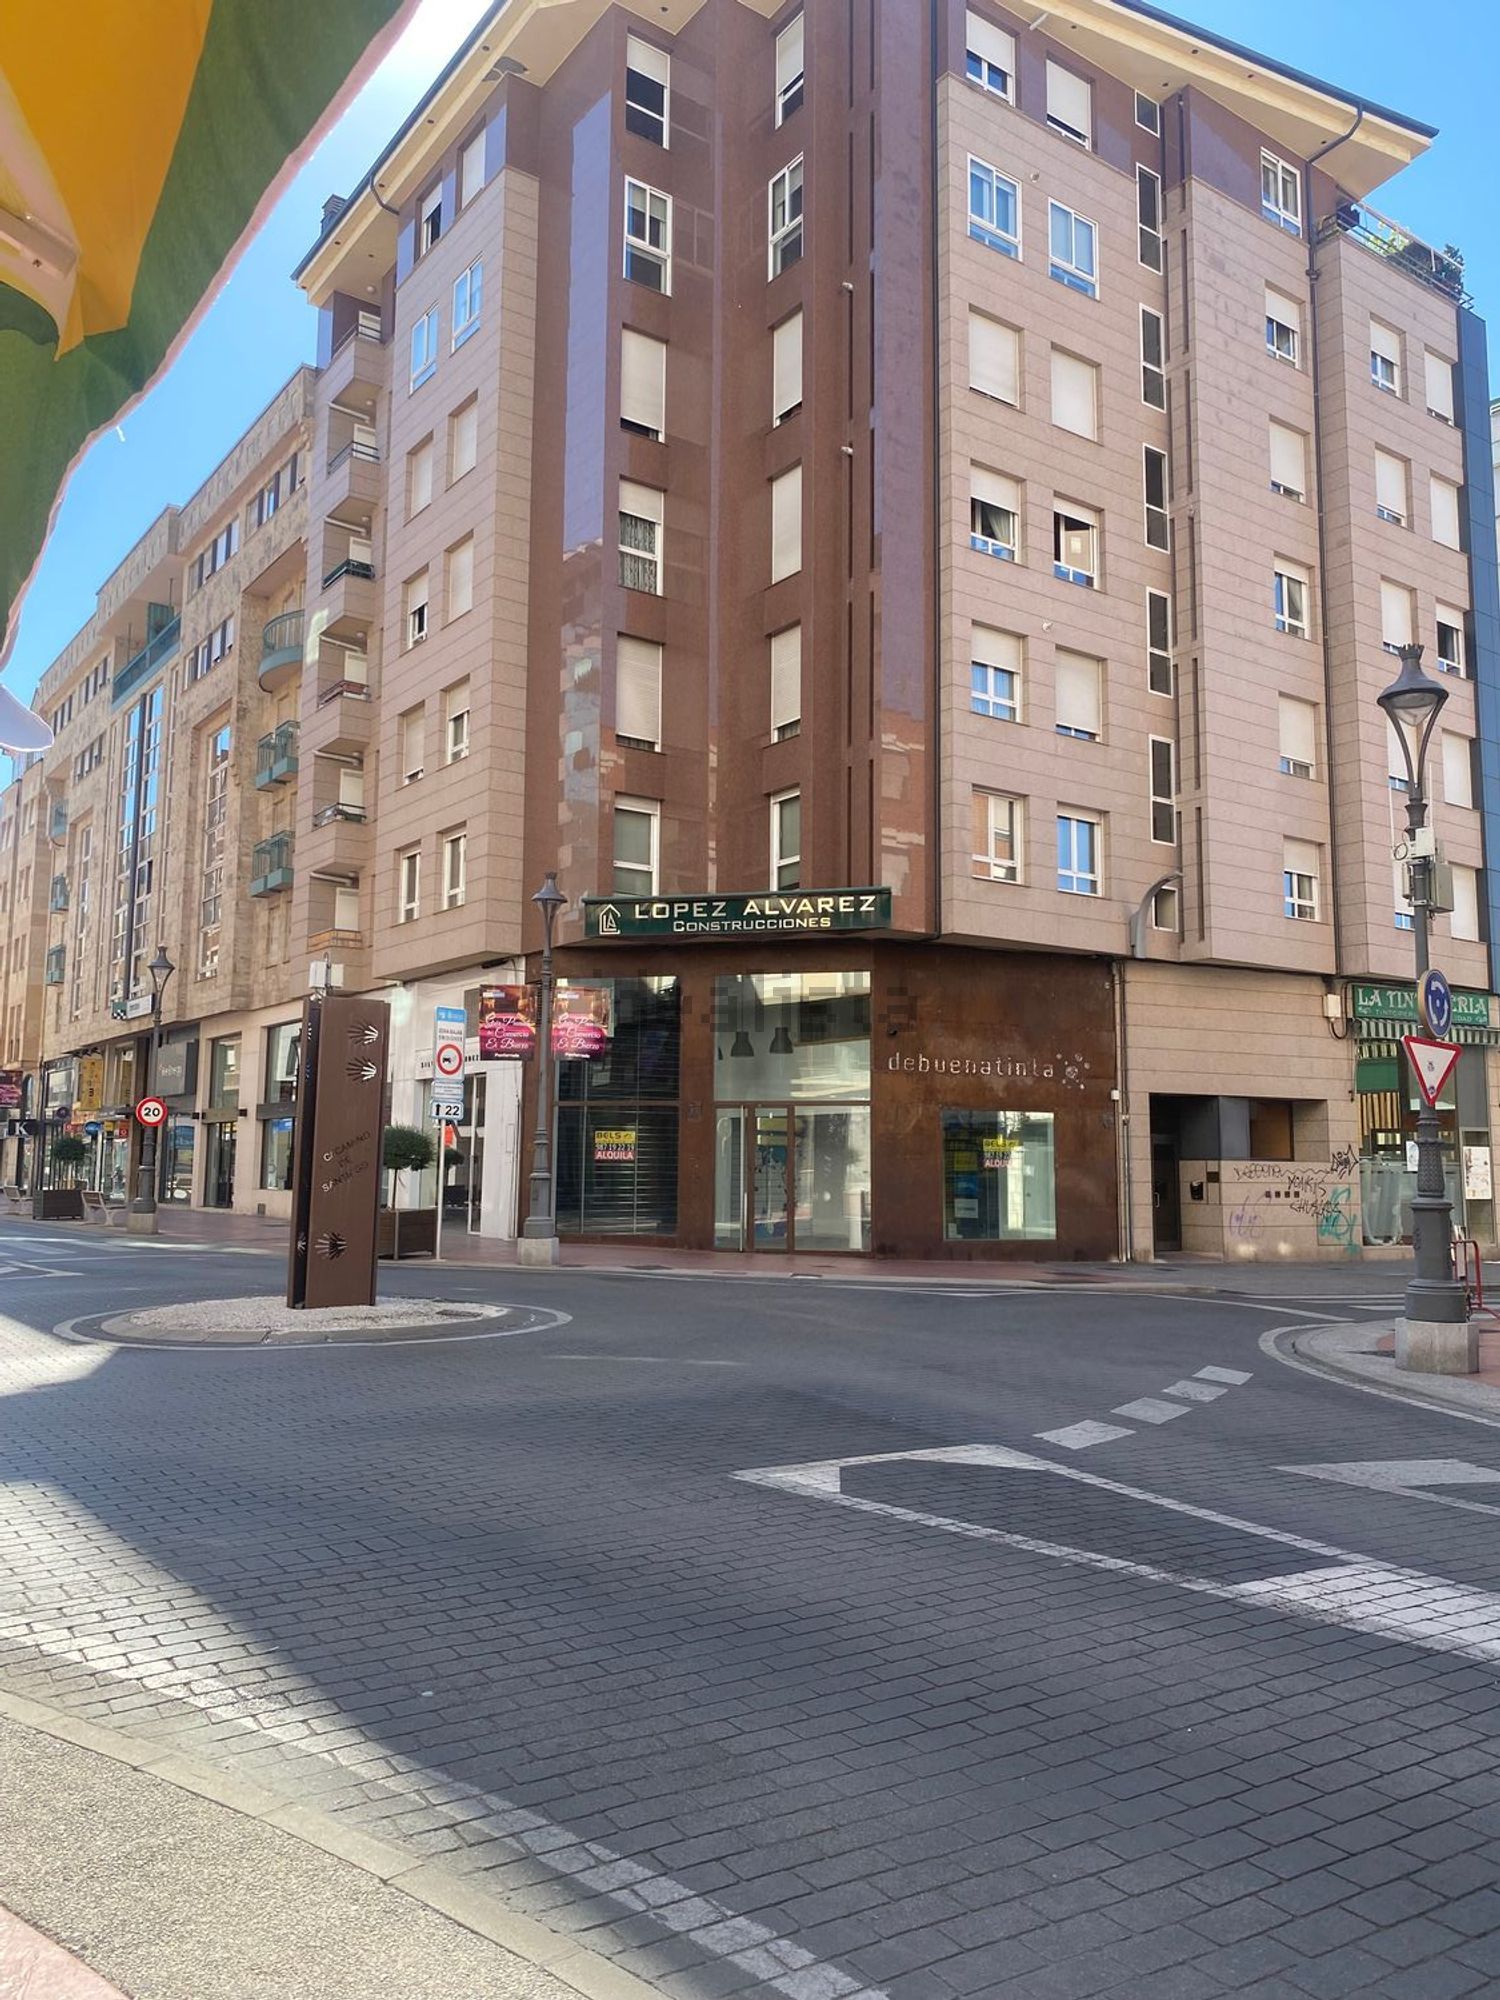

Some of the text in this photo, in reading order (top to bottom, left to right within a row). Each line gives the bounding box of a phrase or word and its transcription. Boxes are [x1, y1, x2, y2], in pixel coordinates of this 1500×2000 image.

[634, 895, 876, 919] LOPEZ ALVAREZ
[673, 917, 832, 932] CONSTRUCCIONES
[1358, 987, 1382, 1007] LA
[888, 1052, 1054, 1079] debuenatinta
[143, 1106, 160, 1117] 20
[445, 1105, 460, 1116] 22
[594, 1150, 635, 1160] ALQUILA
